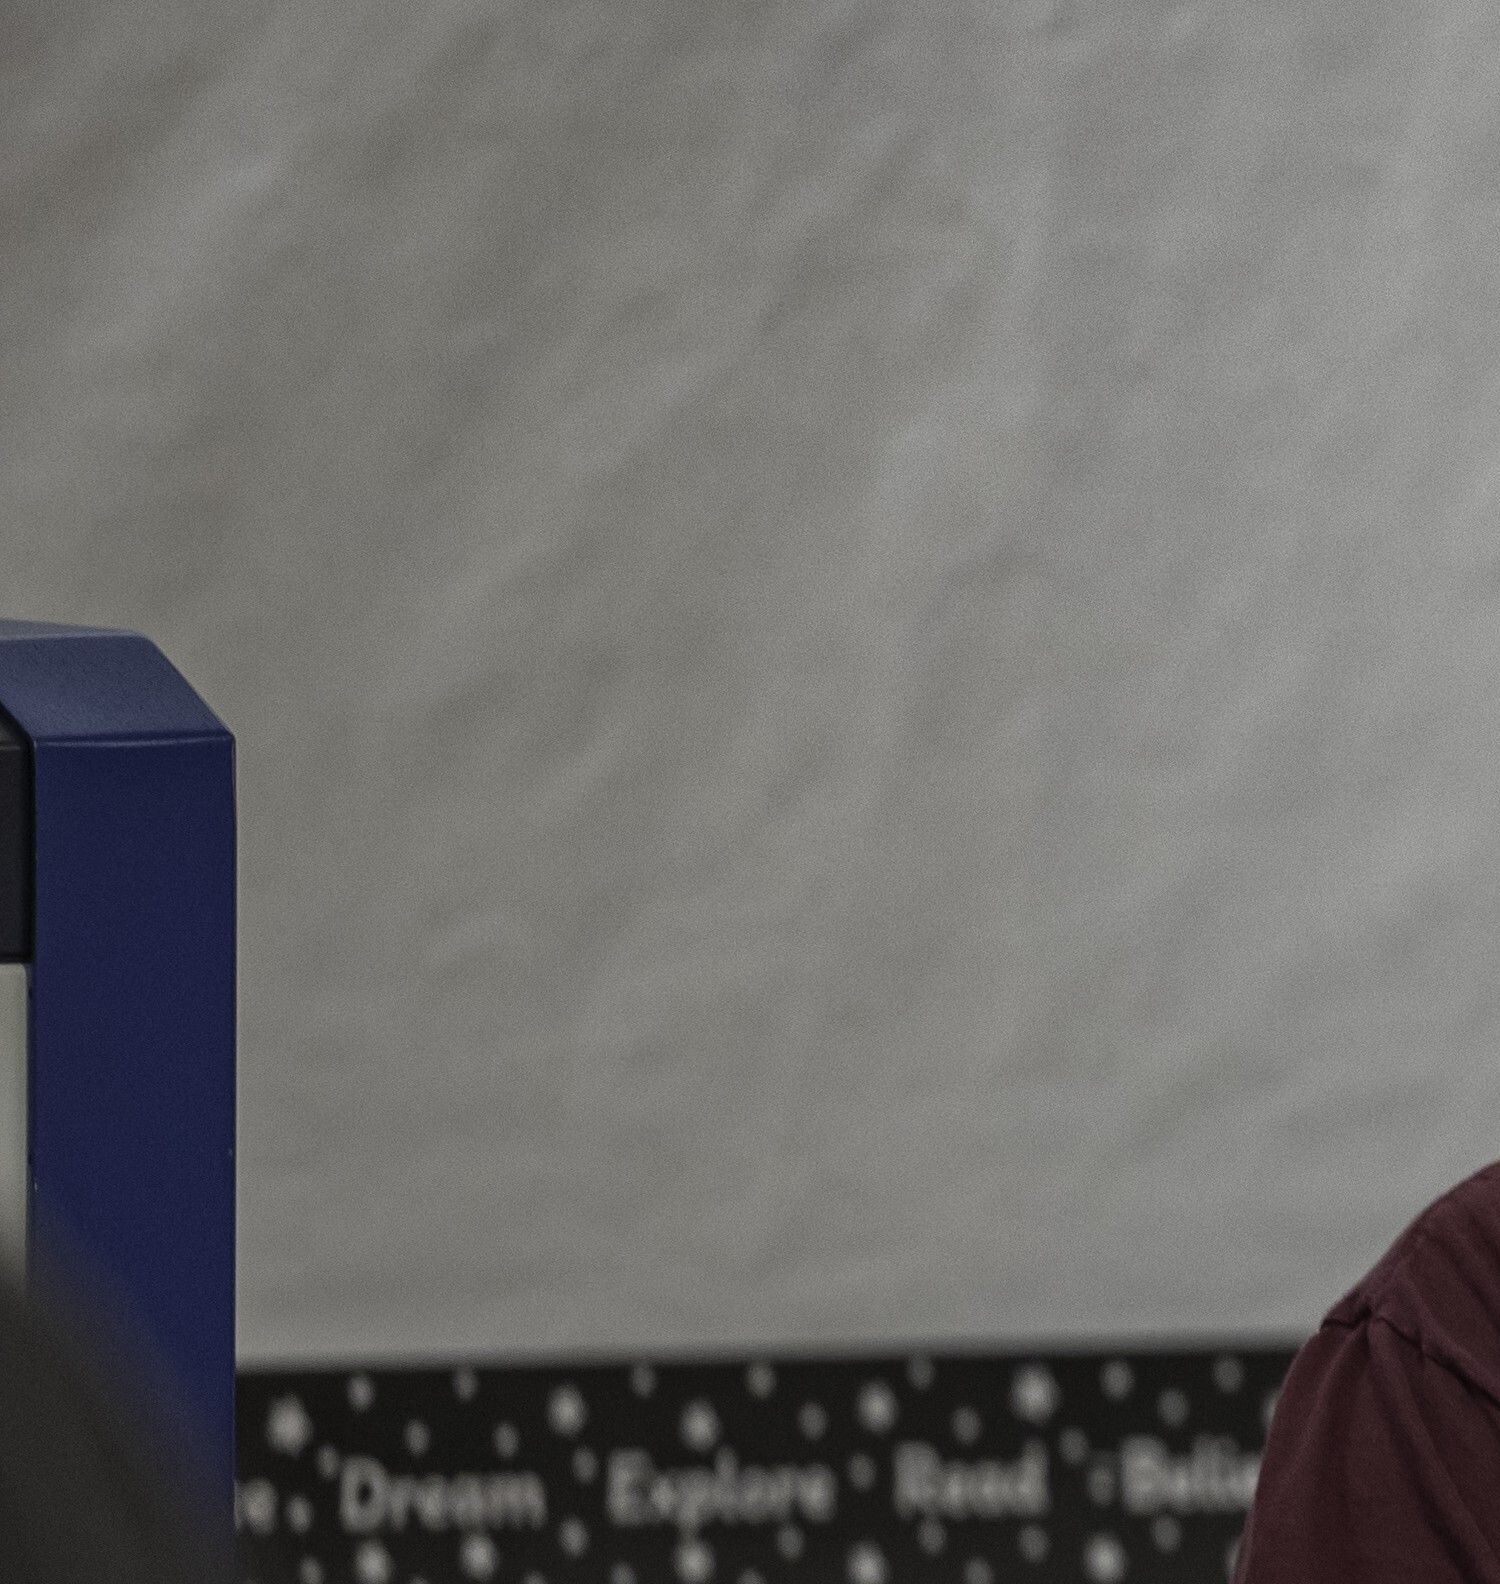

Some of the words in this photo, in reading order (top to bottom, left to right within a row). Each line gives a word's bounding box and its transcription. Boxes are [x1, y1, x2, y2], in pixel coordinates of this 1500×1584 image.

[339, 1456, 547, 1532] Dream
[604, 1448, 838, 1537] Explore
[891, 1436, 1050, 1519] Read
